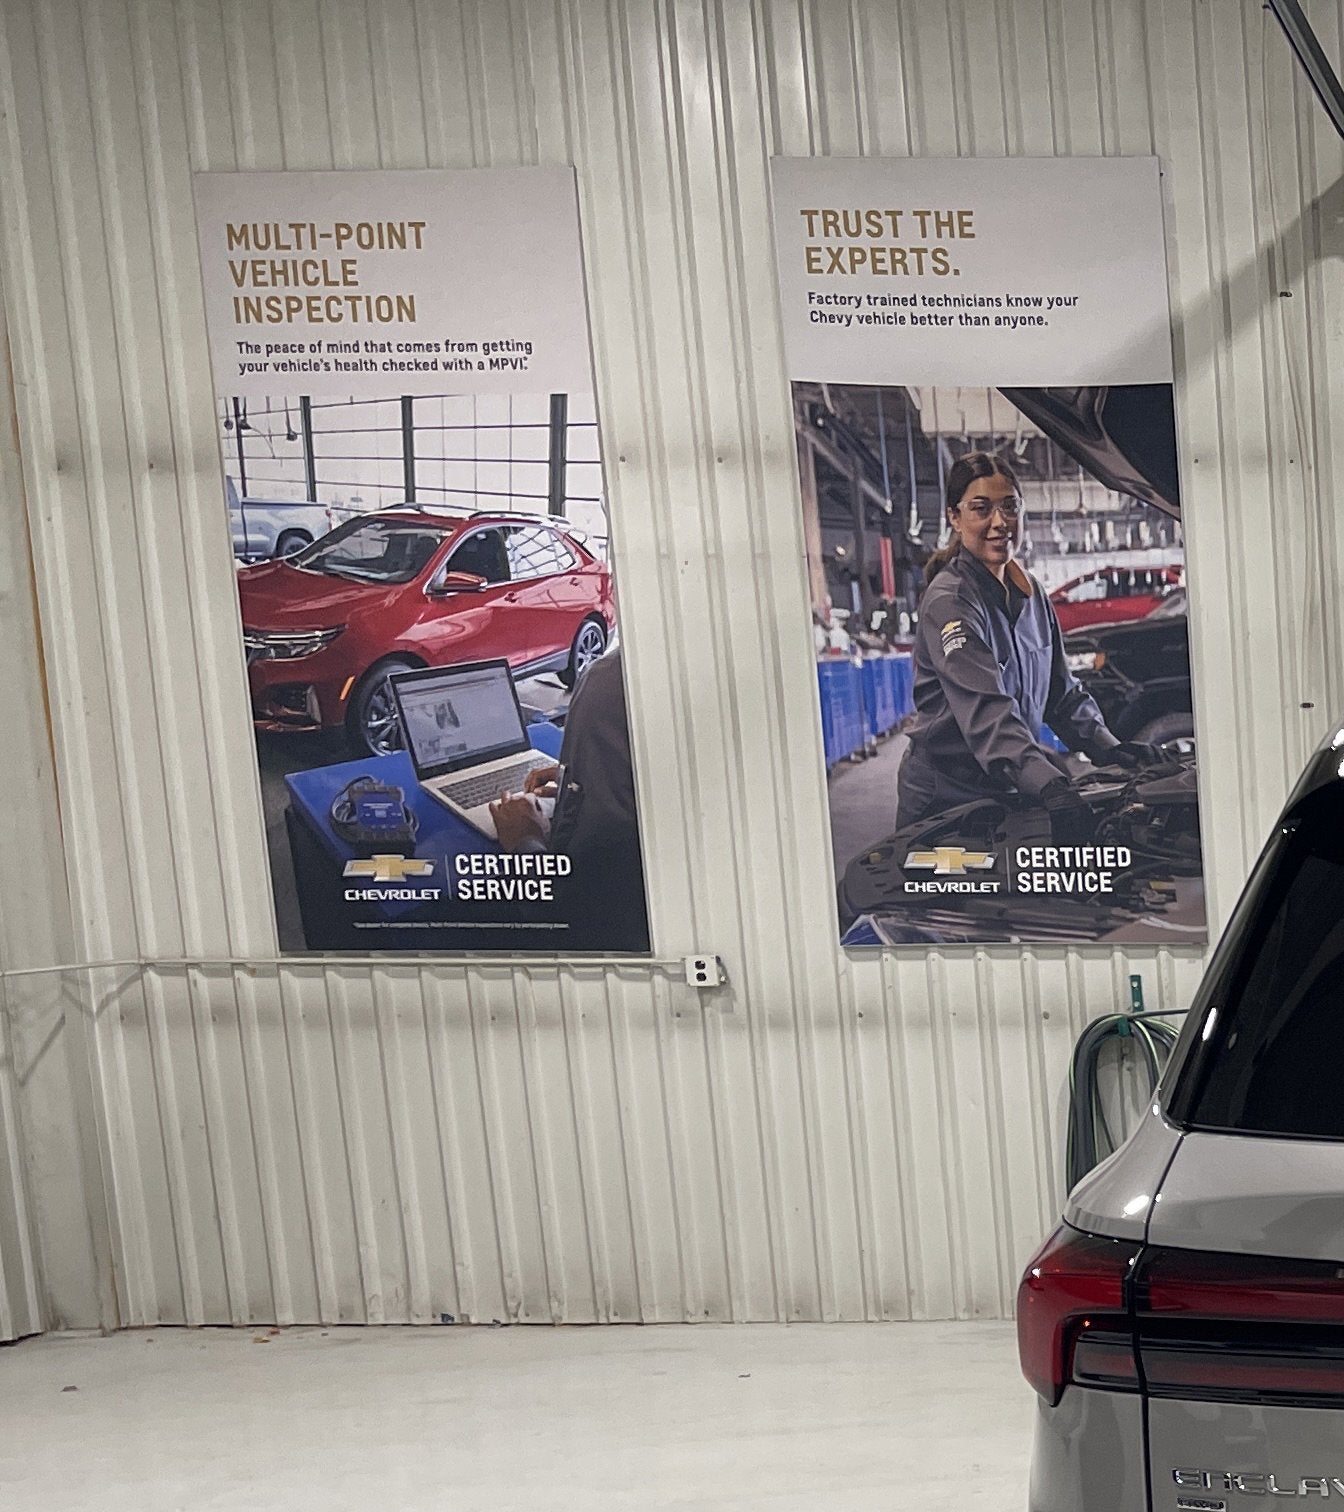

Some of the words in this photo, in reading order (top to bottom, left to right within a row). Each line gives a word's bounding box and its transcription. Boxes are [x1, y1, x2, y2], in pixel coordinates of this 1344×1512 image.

[226, 221, 426, 251] MULTI-POINT
[800, 210, 903, 239] TRUST
[913, 210, 976, 239] THE
[805, 247, 961, 276] EXPERTS.
[229, 259, 359, 288] VEHICLE
[233, 295, 417, 324] INSPECTION
[808, 292, 862, 308] Factory
[867, 293, 917, 307] trained
[921, 293, 1002, 308] technicians
[1006, 294, 1043, 308] know
[1046, 295, 1079, 310] your
[810, 311, 853, 327] Chevy
[856, 312, 906, 326] vehicle
[910, 312, 954, 326] better
[958, 312, 990, 326] than
[994, 314, 1049, 328] anyone.
[237, 341, 263, 355] The
[265, 343, 305, 356] peace
[309, 340, 323, 354] of
[326, 340, 359, 354] mind
[364, 340, 393, 353] that
[397, 341, 440, 353] comes
[444, 339, 478, 353] from
[482, 339, 533, 356] getting
[238, 361, 269, 375] your
[273, 358, 331, 372] vehicle's
[335, 358, 377, 372] health
[382, 358, 438, 371] checked
[442, 358, 473, 371] with
[477, 360, 485, 371] a
[455, 853, 571, 876] CERTIFIED
[1015, 846, 1131, 868] CERTIFIED
[457, 878, 554, 901] SERVICE
[904, 881, 1001, 894] CHEVROLET
[1017, 871, 1113, 894] SERVICE
[344, 888, 442, 901] CHEVROLET
